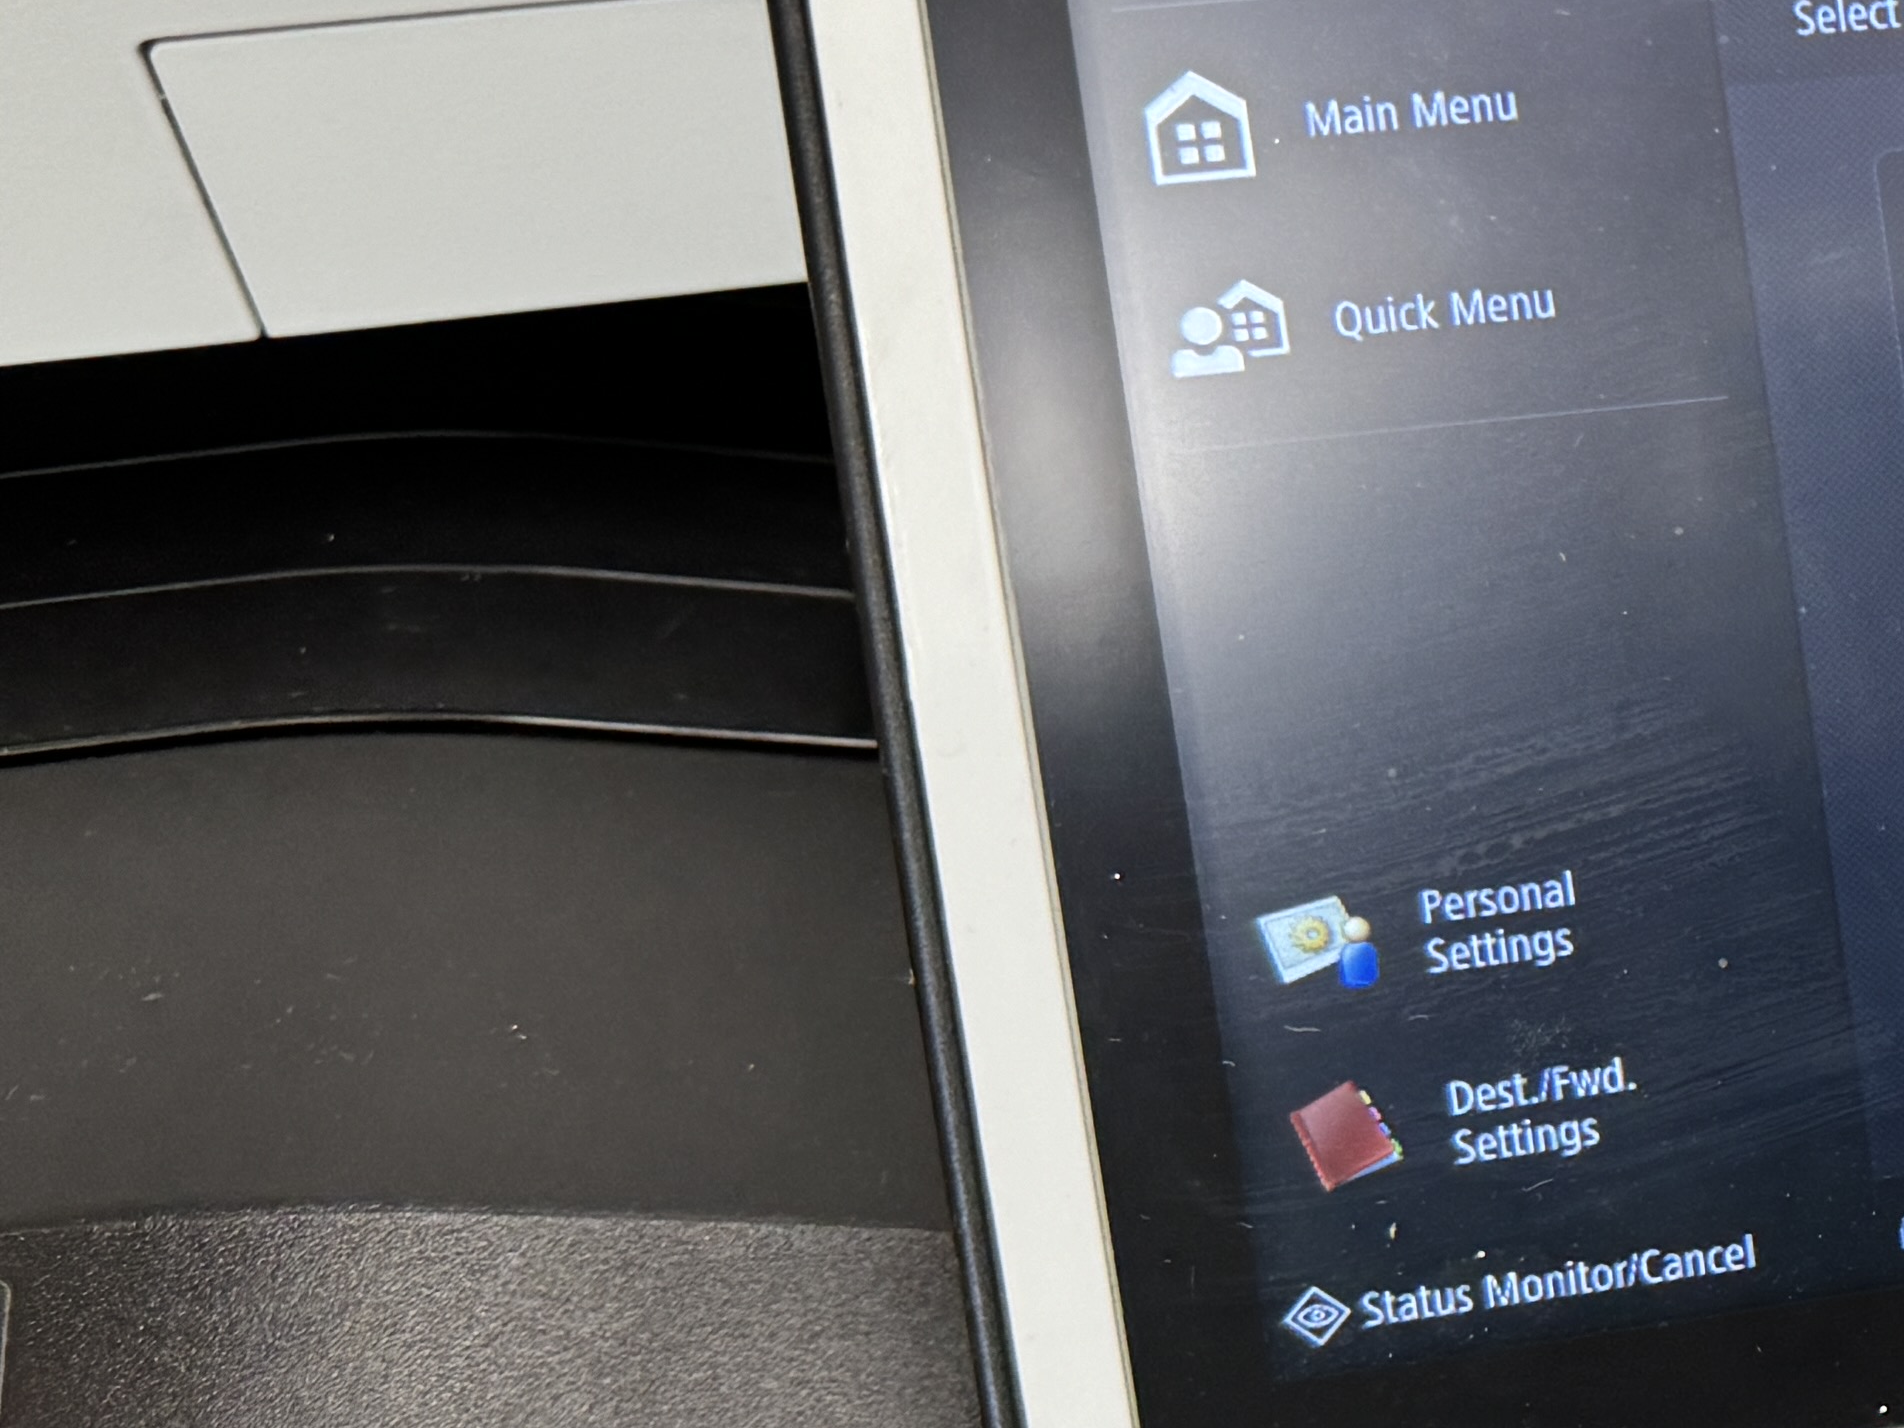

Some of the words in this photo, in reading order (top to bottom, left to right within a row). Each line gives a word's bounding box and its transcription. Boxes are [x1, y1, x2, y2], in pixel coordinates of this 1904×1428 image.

[1305, 95, 1400, 139] Main
[1411, 89, 1519, 129] Menu
[1334, 294, 1440, 343] Quick
[1450, 286, 1557, 328] Menu
[1419, 869, 1577, 925] Personal
[1424, 926, 1575, 974] Settings
[1445, 1055, 1639, 1117] Dest./Fwd.
[1453, 1115, 1601, 1166] Settings
[1360, 1283, 1475, 1331] Status
[1482, 1233, 1758, 1311] Monitor/Cancel
